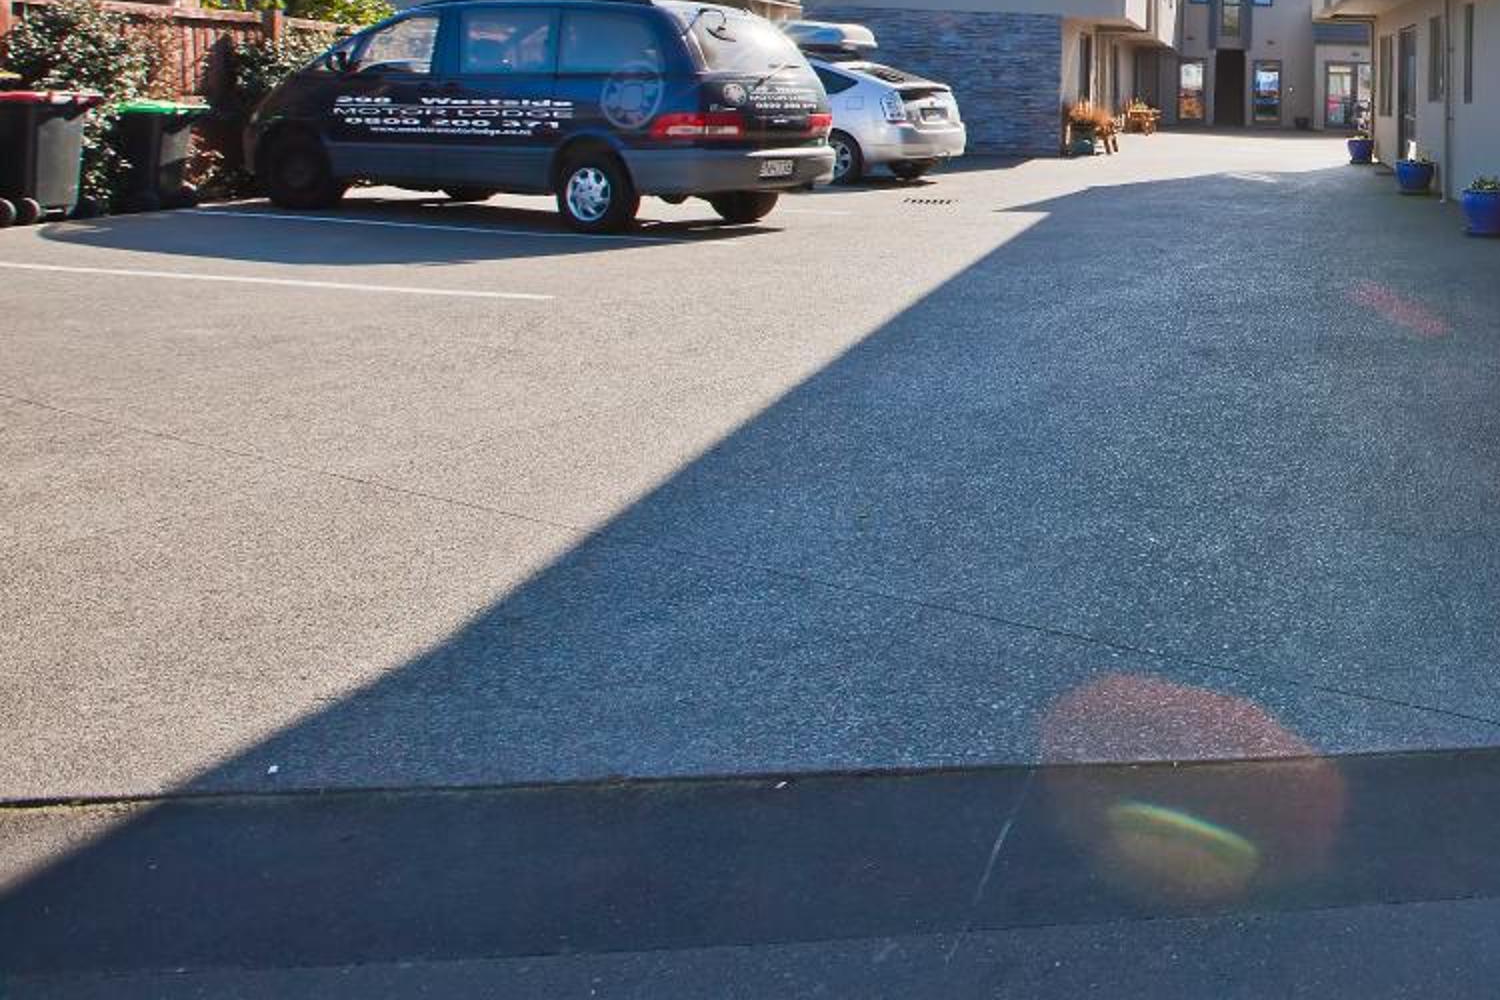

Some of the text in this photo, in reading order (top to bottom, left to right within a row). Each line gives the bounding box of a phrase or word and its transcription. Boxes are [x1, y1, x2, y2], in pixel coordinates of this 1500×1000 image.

[420, 97, 574, 107] Westside
[333, 107, 574, 119] MOTOR LODGE
[344, 116, 421, 126] 0800
